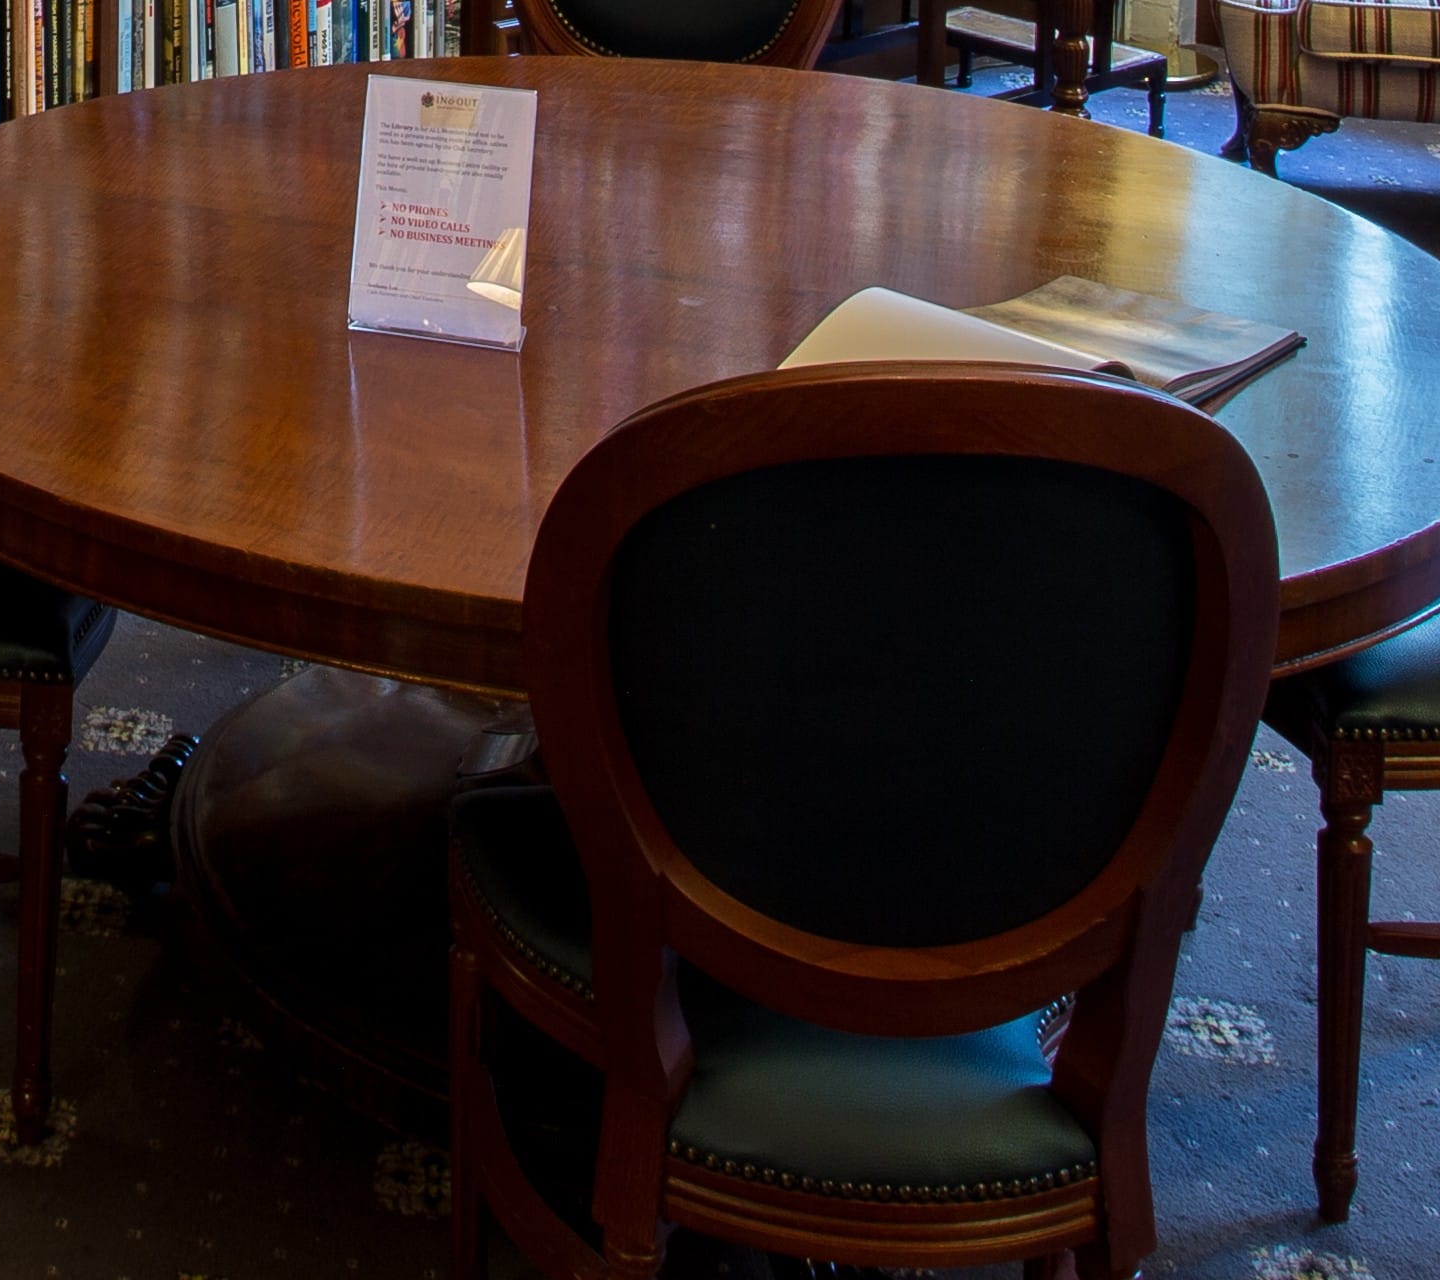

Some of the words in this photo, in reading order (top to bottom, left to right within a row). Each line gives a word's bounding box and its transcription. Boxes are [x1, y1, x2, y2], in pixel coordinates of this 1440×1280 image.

[392, 203, 406, 212] NO
[408, 204, 448, 217] PHONES
[391, 216, 405, 225] NO
[408, 218, 438, 229] VIDEO
[440, 221, 470, 232] CALLS
[391, 229, 404, 238] NO
[407, 231, 453, 244] BUSINESS
